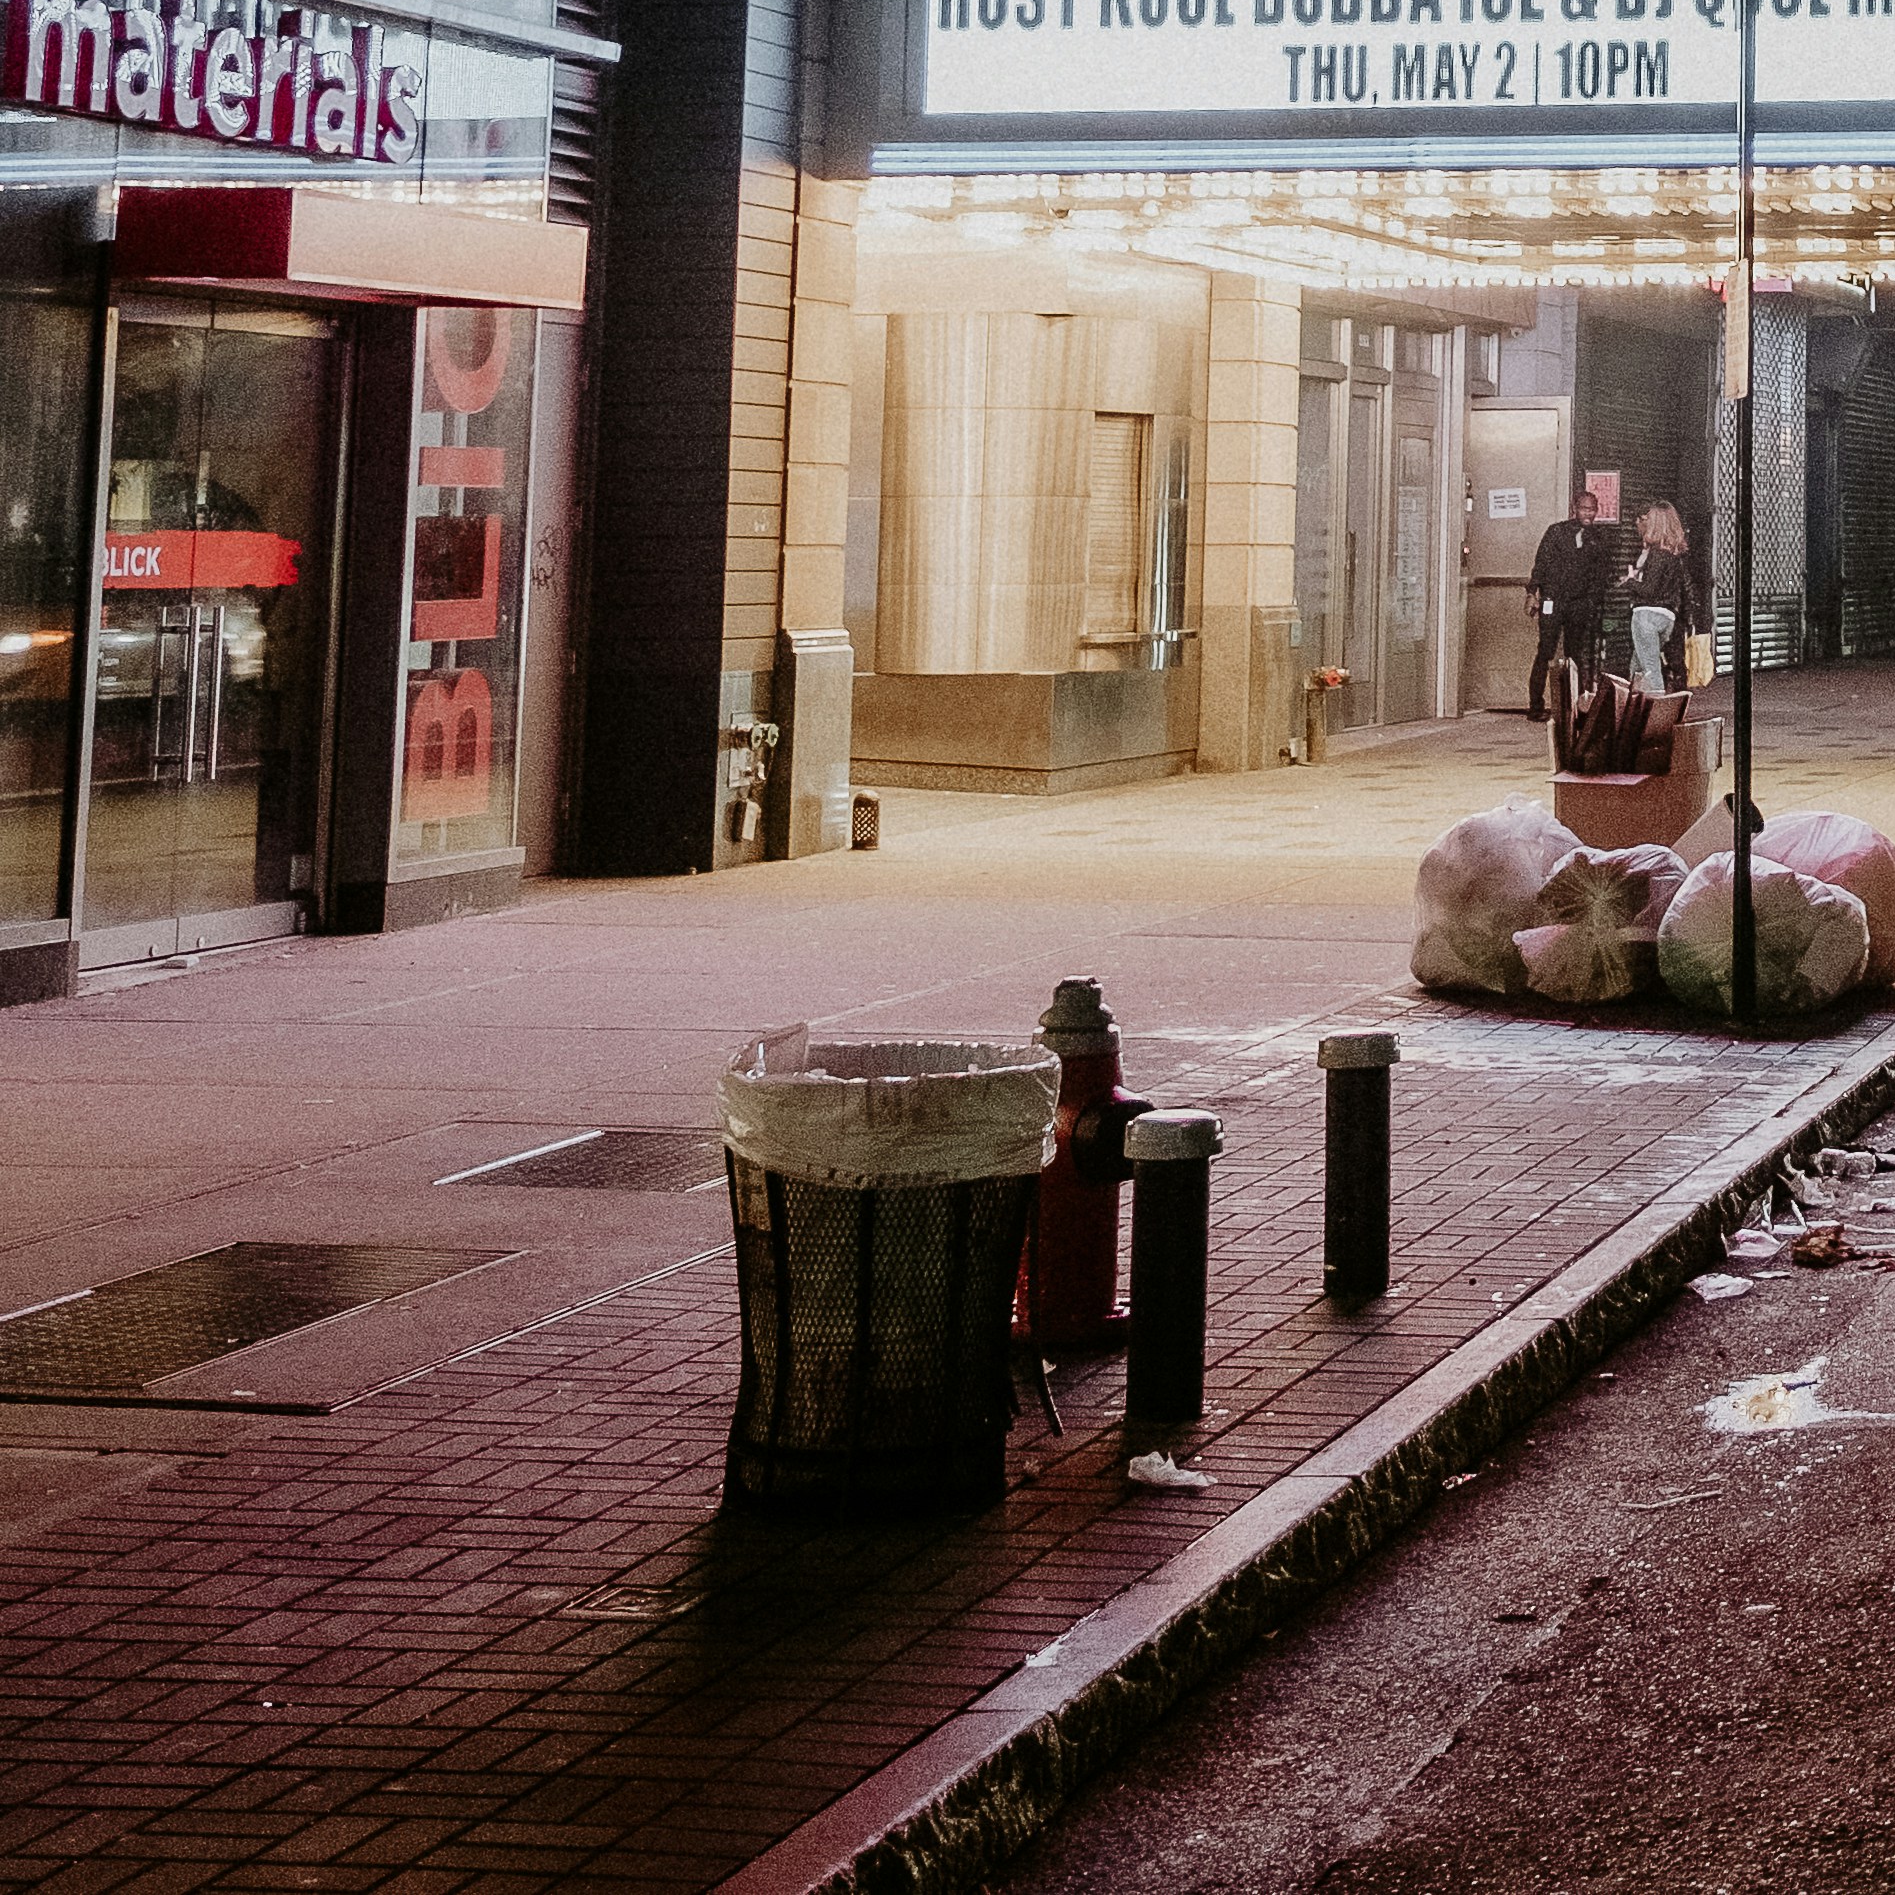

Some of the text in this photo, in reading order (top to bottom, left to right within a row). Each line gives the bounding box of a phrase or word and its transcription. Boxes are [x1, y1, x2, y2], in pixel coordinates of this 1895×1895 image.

[1283, 43, 1378, 106] THU,
[1392, 42, 1480, 102] MAY
[1494, 40, 1518, 101] 2
[1556, 39, 1671, 99] 10PM
